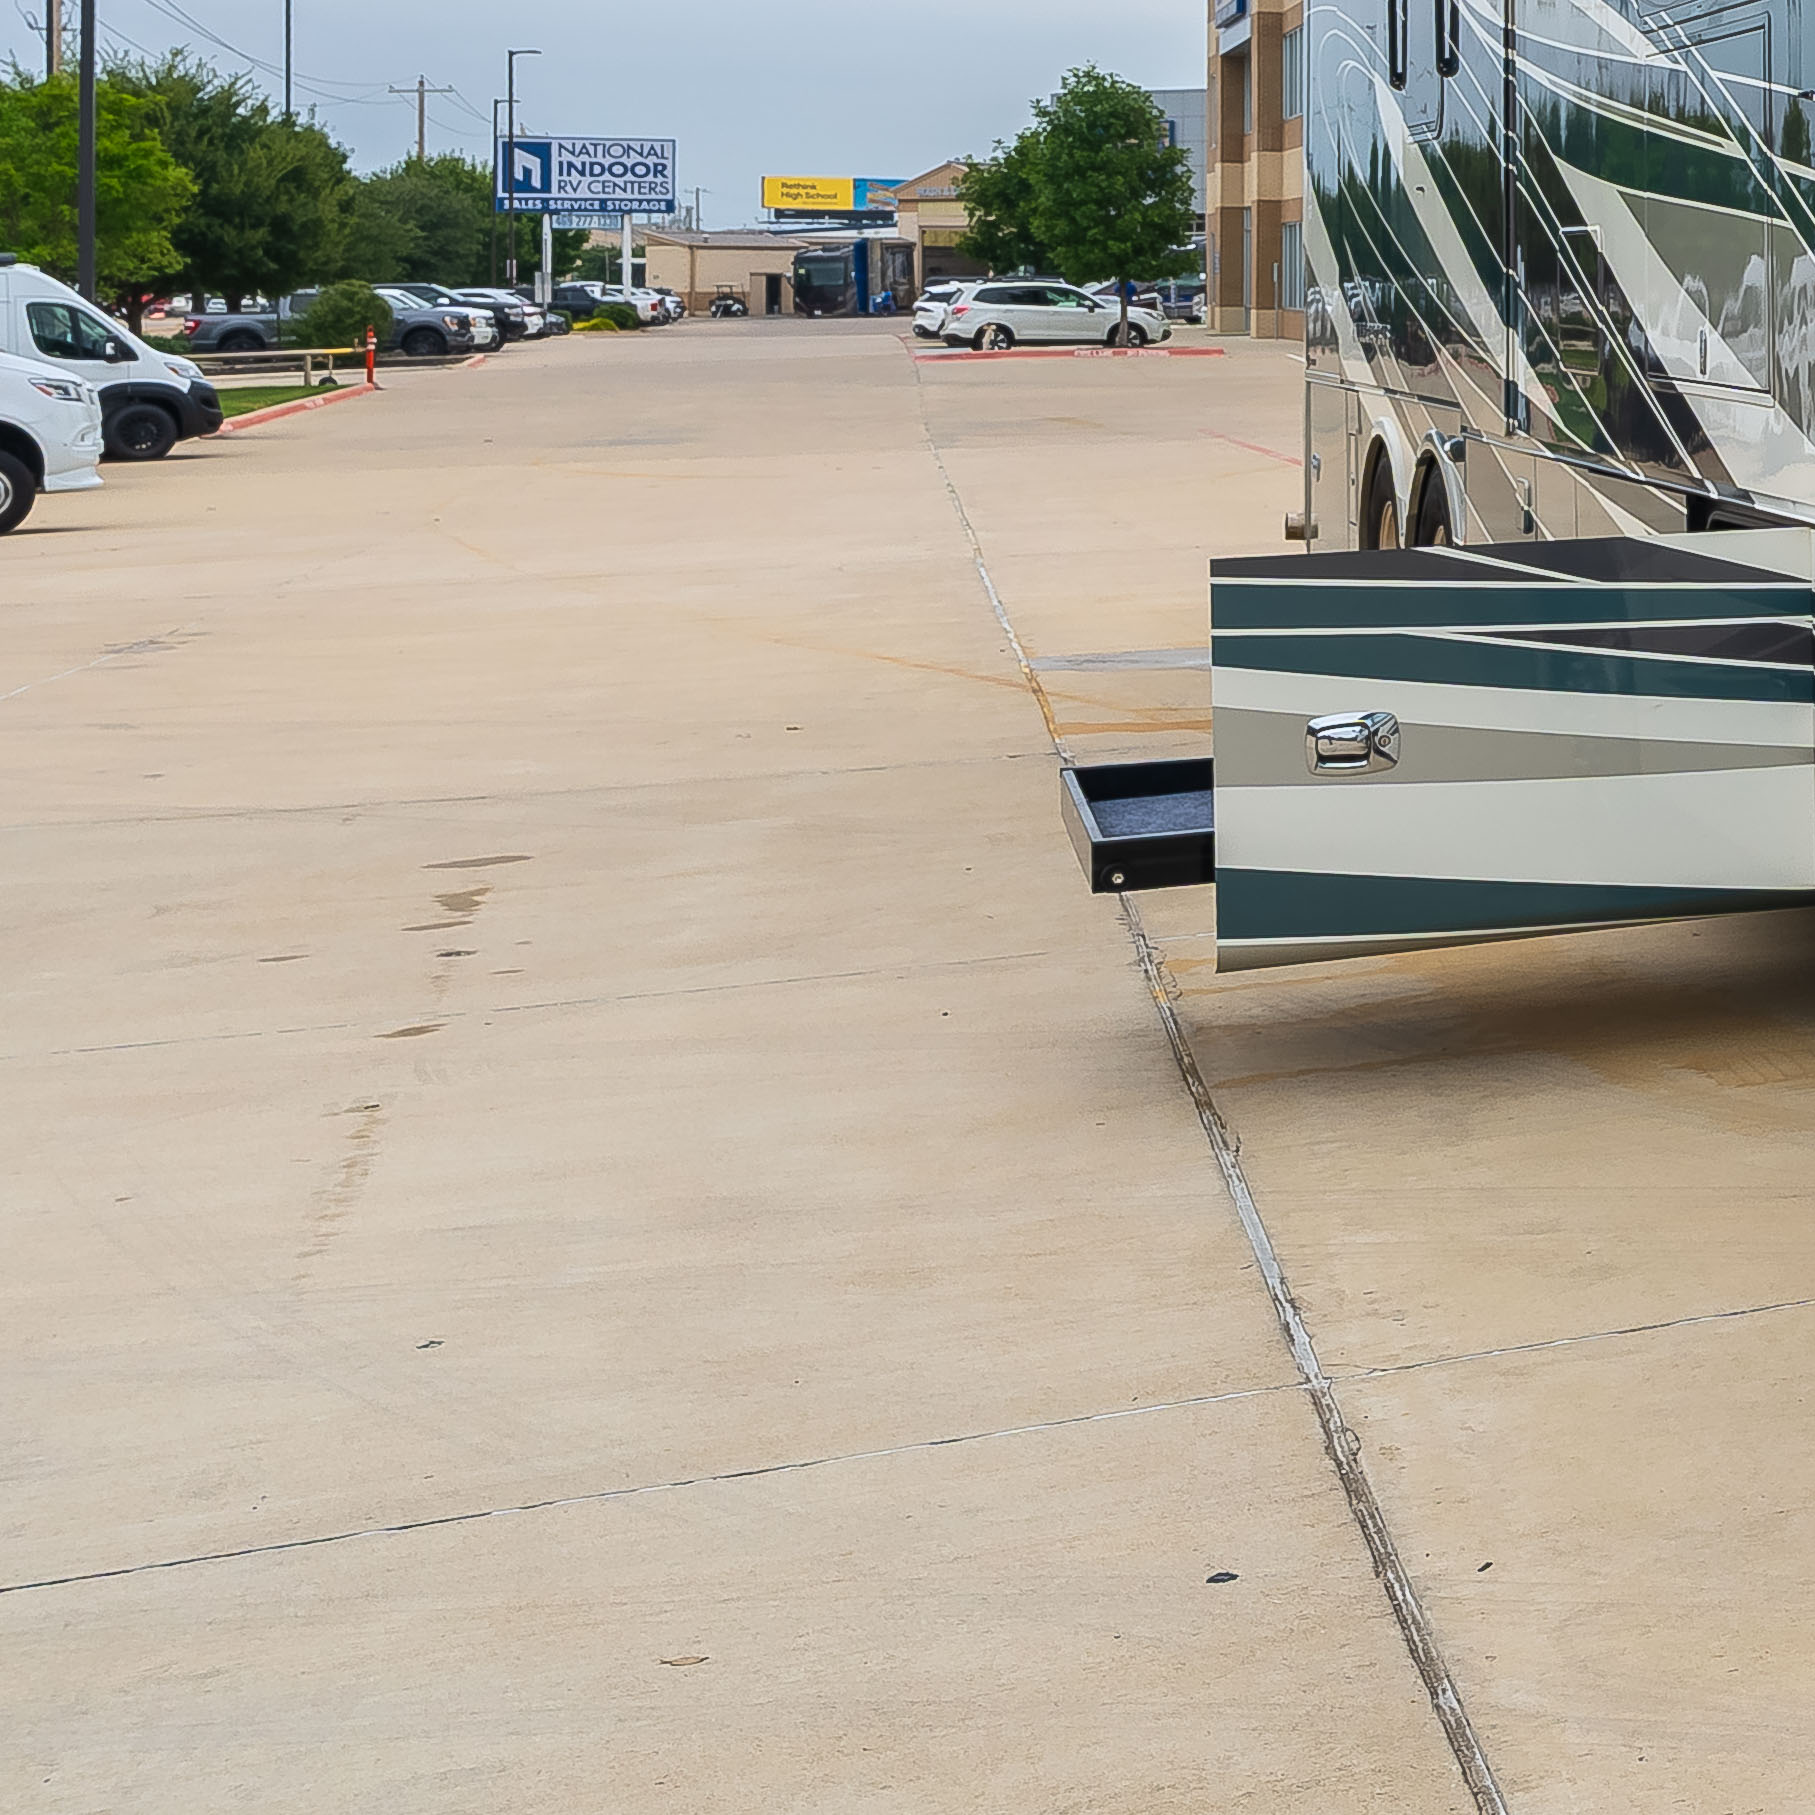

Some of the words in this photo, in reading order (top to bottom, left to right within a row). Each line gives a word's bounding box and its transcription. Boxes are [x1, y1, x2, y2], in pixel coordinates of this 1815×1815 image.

[558, 142, 669, 160] NATIONAL
[558, 160, 669, 179] INDOOR
[558, 180, 582, 194] RV
[587, 181, 670, 195] CENTERS
[781, 192, 803, 200] High
[805, 192, 838, 200] School
[503, 199, 543, 210] SALES
[549, 199, 600, 210] SERVICE
[606, 200, 667, 211] STORAGE
